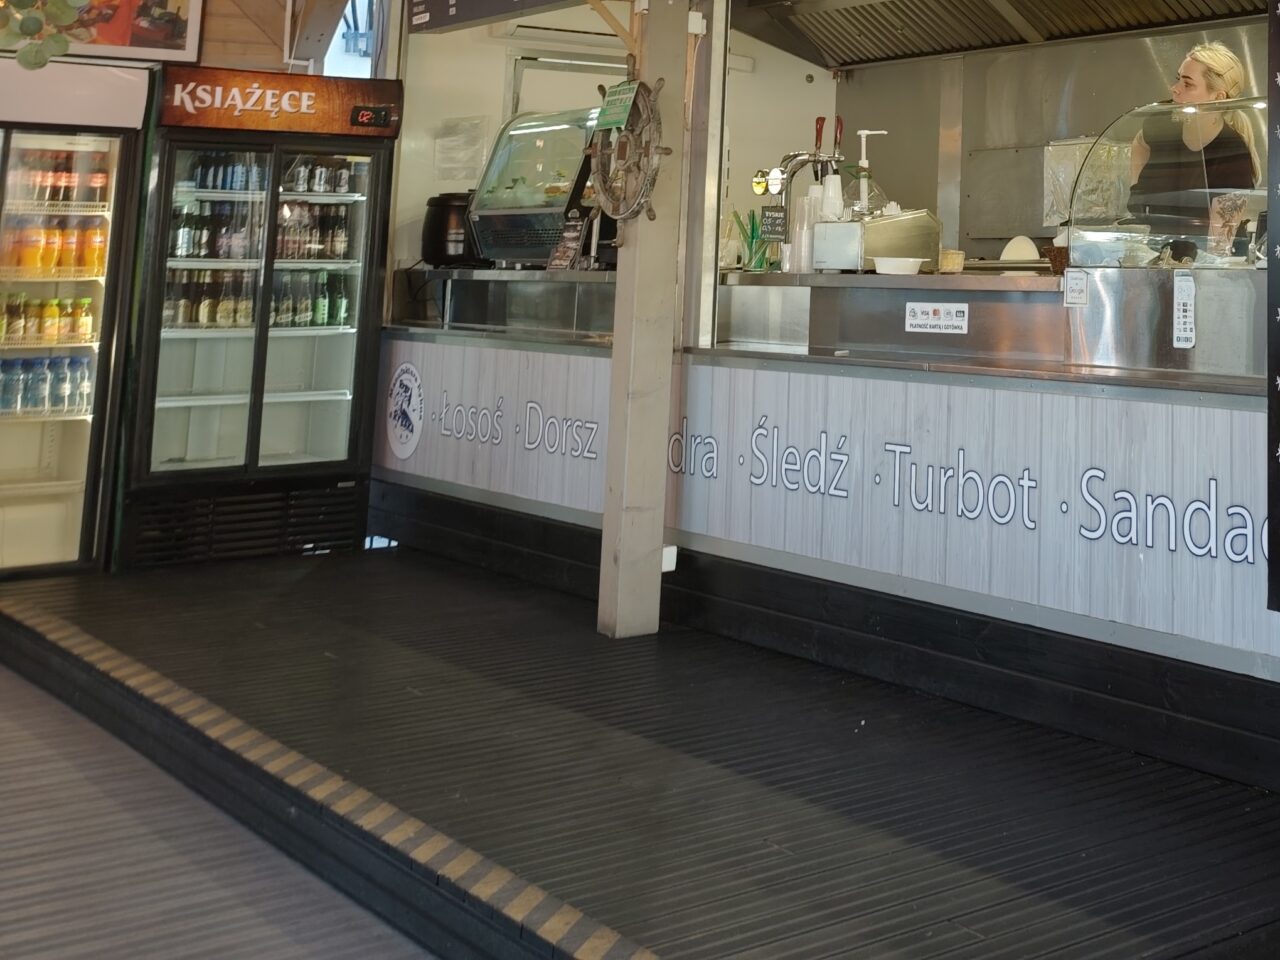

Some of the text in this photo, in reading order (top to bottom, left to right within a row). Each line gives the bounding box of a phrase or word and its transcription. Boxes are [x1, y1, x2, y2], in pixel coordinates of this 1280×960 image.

[173, 82, 316, 118] KSIĄŻĘCE
[438, 390, 504, 445] Łosoś
[524, 401, 599, 460] Dorsz
[667, 417, 719, 479] dra
[749, 415, 849, 498] Śledź
[884, 442, 1038, 530] Turbot
[1079, 467, 1269, 565] Sanda
